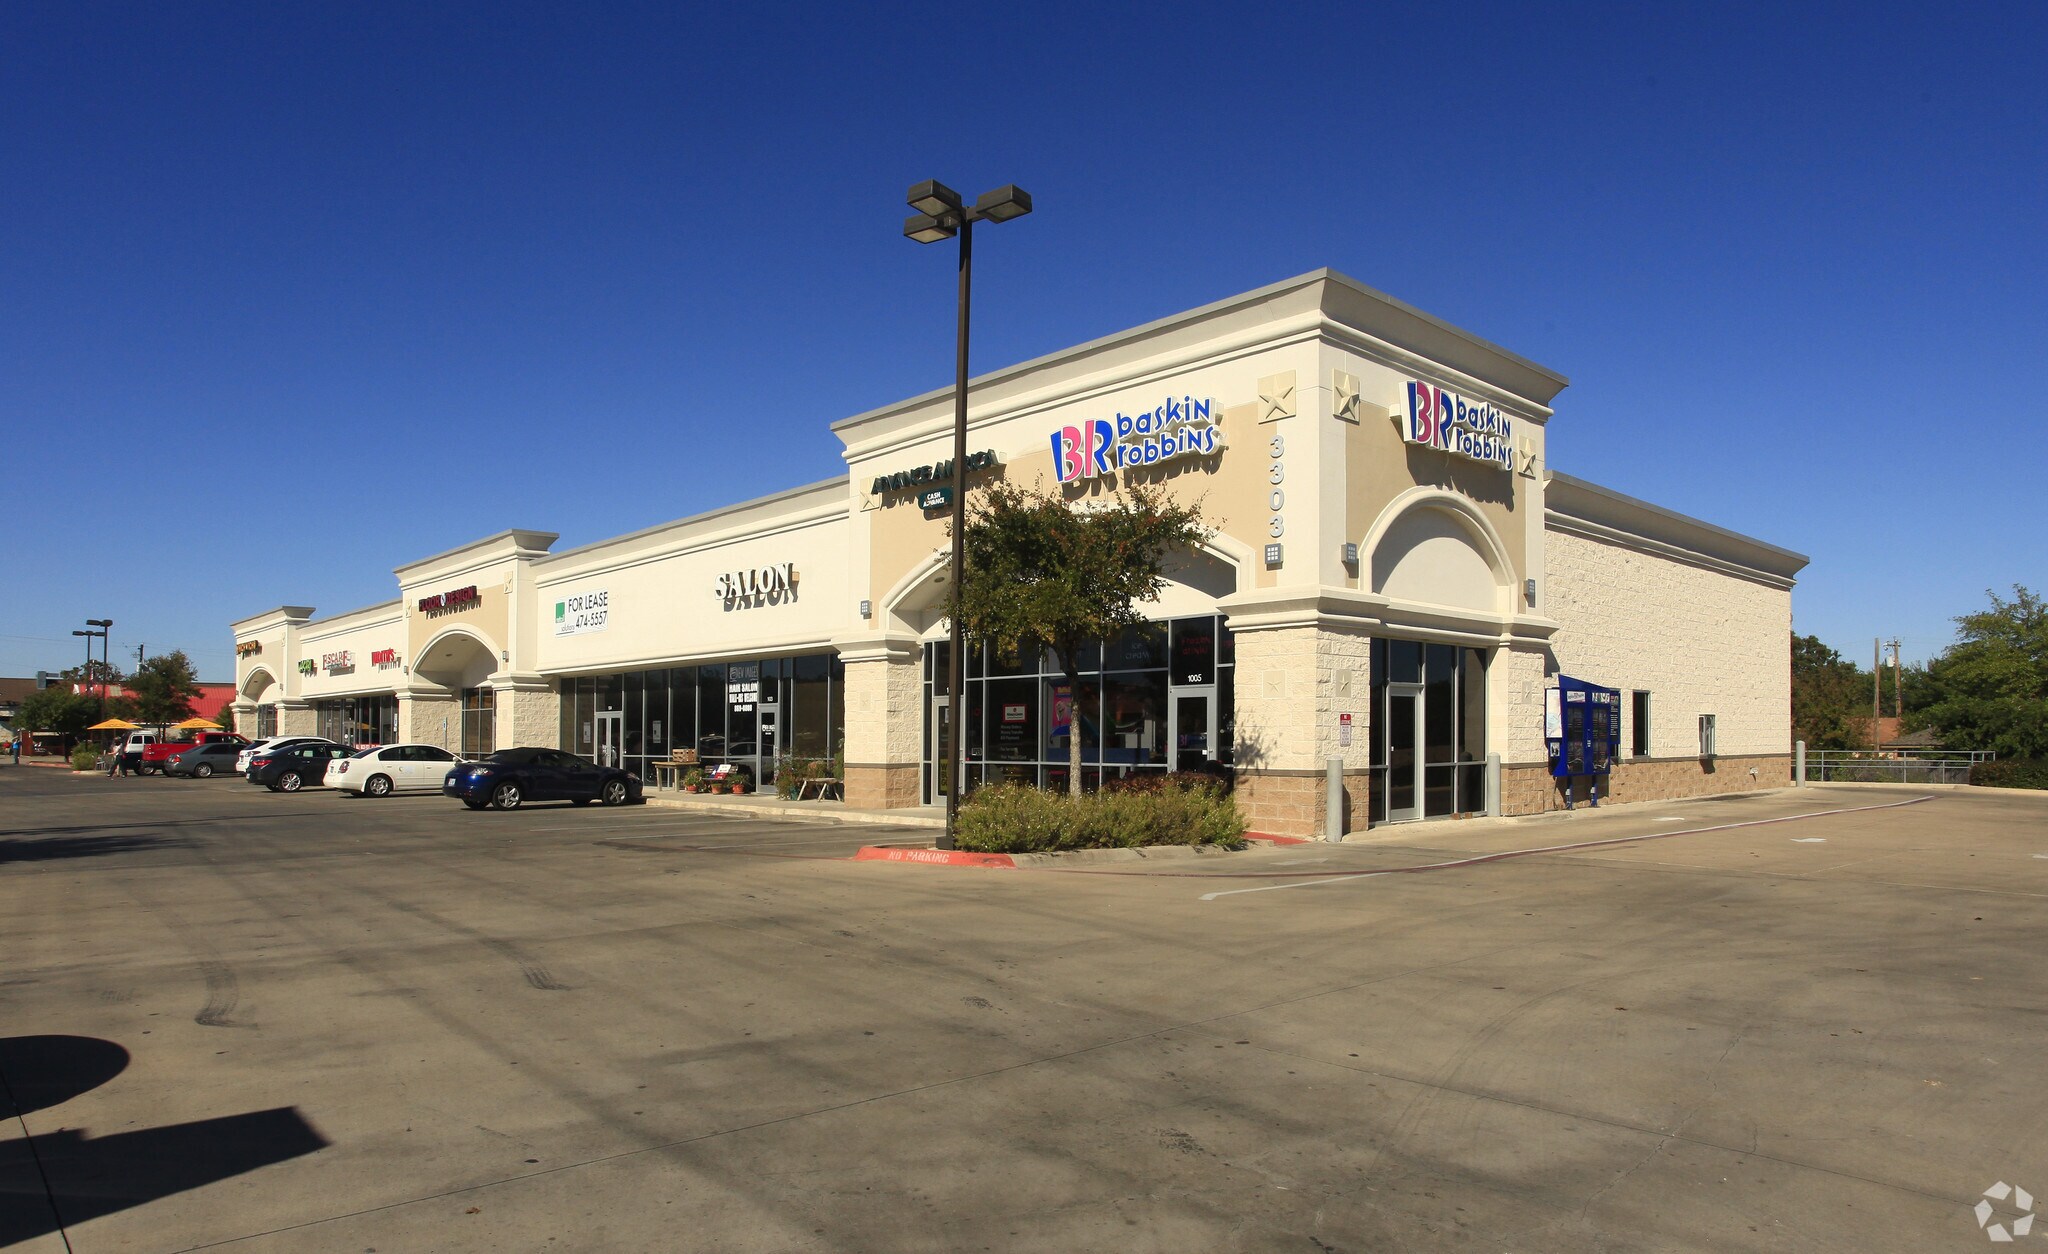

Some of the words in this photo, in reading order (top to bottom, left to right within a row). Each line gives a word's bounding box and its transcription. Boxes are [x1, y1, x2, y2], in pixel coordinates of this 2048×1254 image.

[1116, 395, 1211, 439] baskin
[1407, 380, 1453, 449] BR
[1456, 394, 1511, 439] baskin
[1050, 419, 1113, 483] BR
[1116, 425, 1215, 468] robbins
[1457, 428, 1513, 470] robbins
[926, 491, 941, 501] CASH
[1269, 435, 1284, 538] 3303
[922, 498, 945, 508] ADVANCE
[445, 585, 477, 605] DESIGN
[715, 562, 793, 601] SALON
[568, 597, 584, 613] FOR
[584, 591, 608, 610] LEASE
[575, 610, 608, 628] 474-5557
[322, 650, 348, 670] ESCAPE
[1187, 674, 1202, 682] 1005
[888, 851, 902, 860] NO
[906, 851, 949, 863] PARKING
